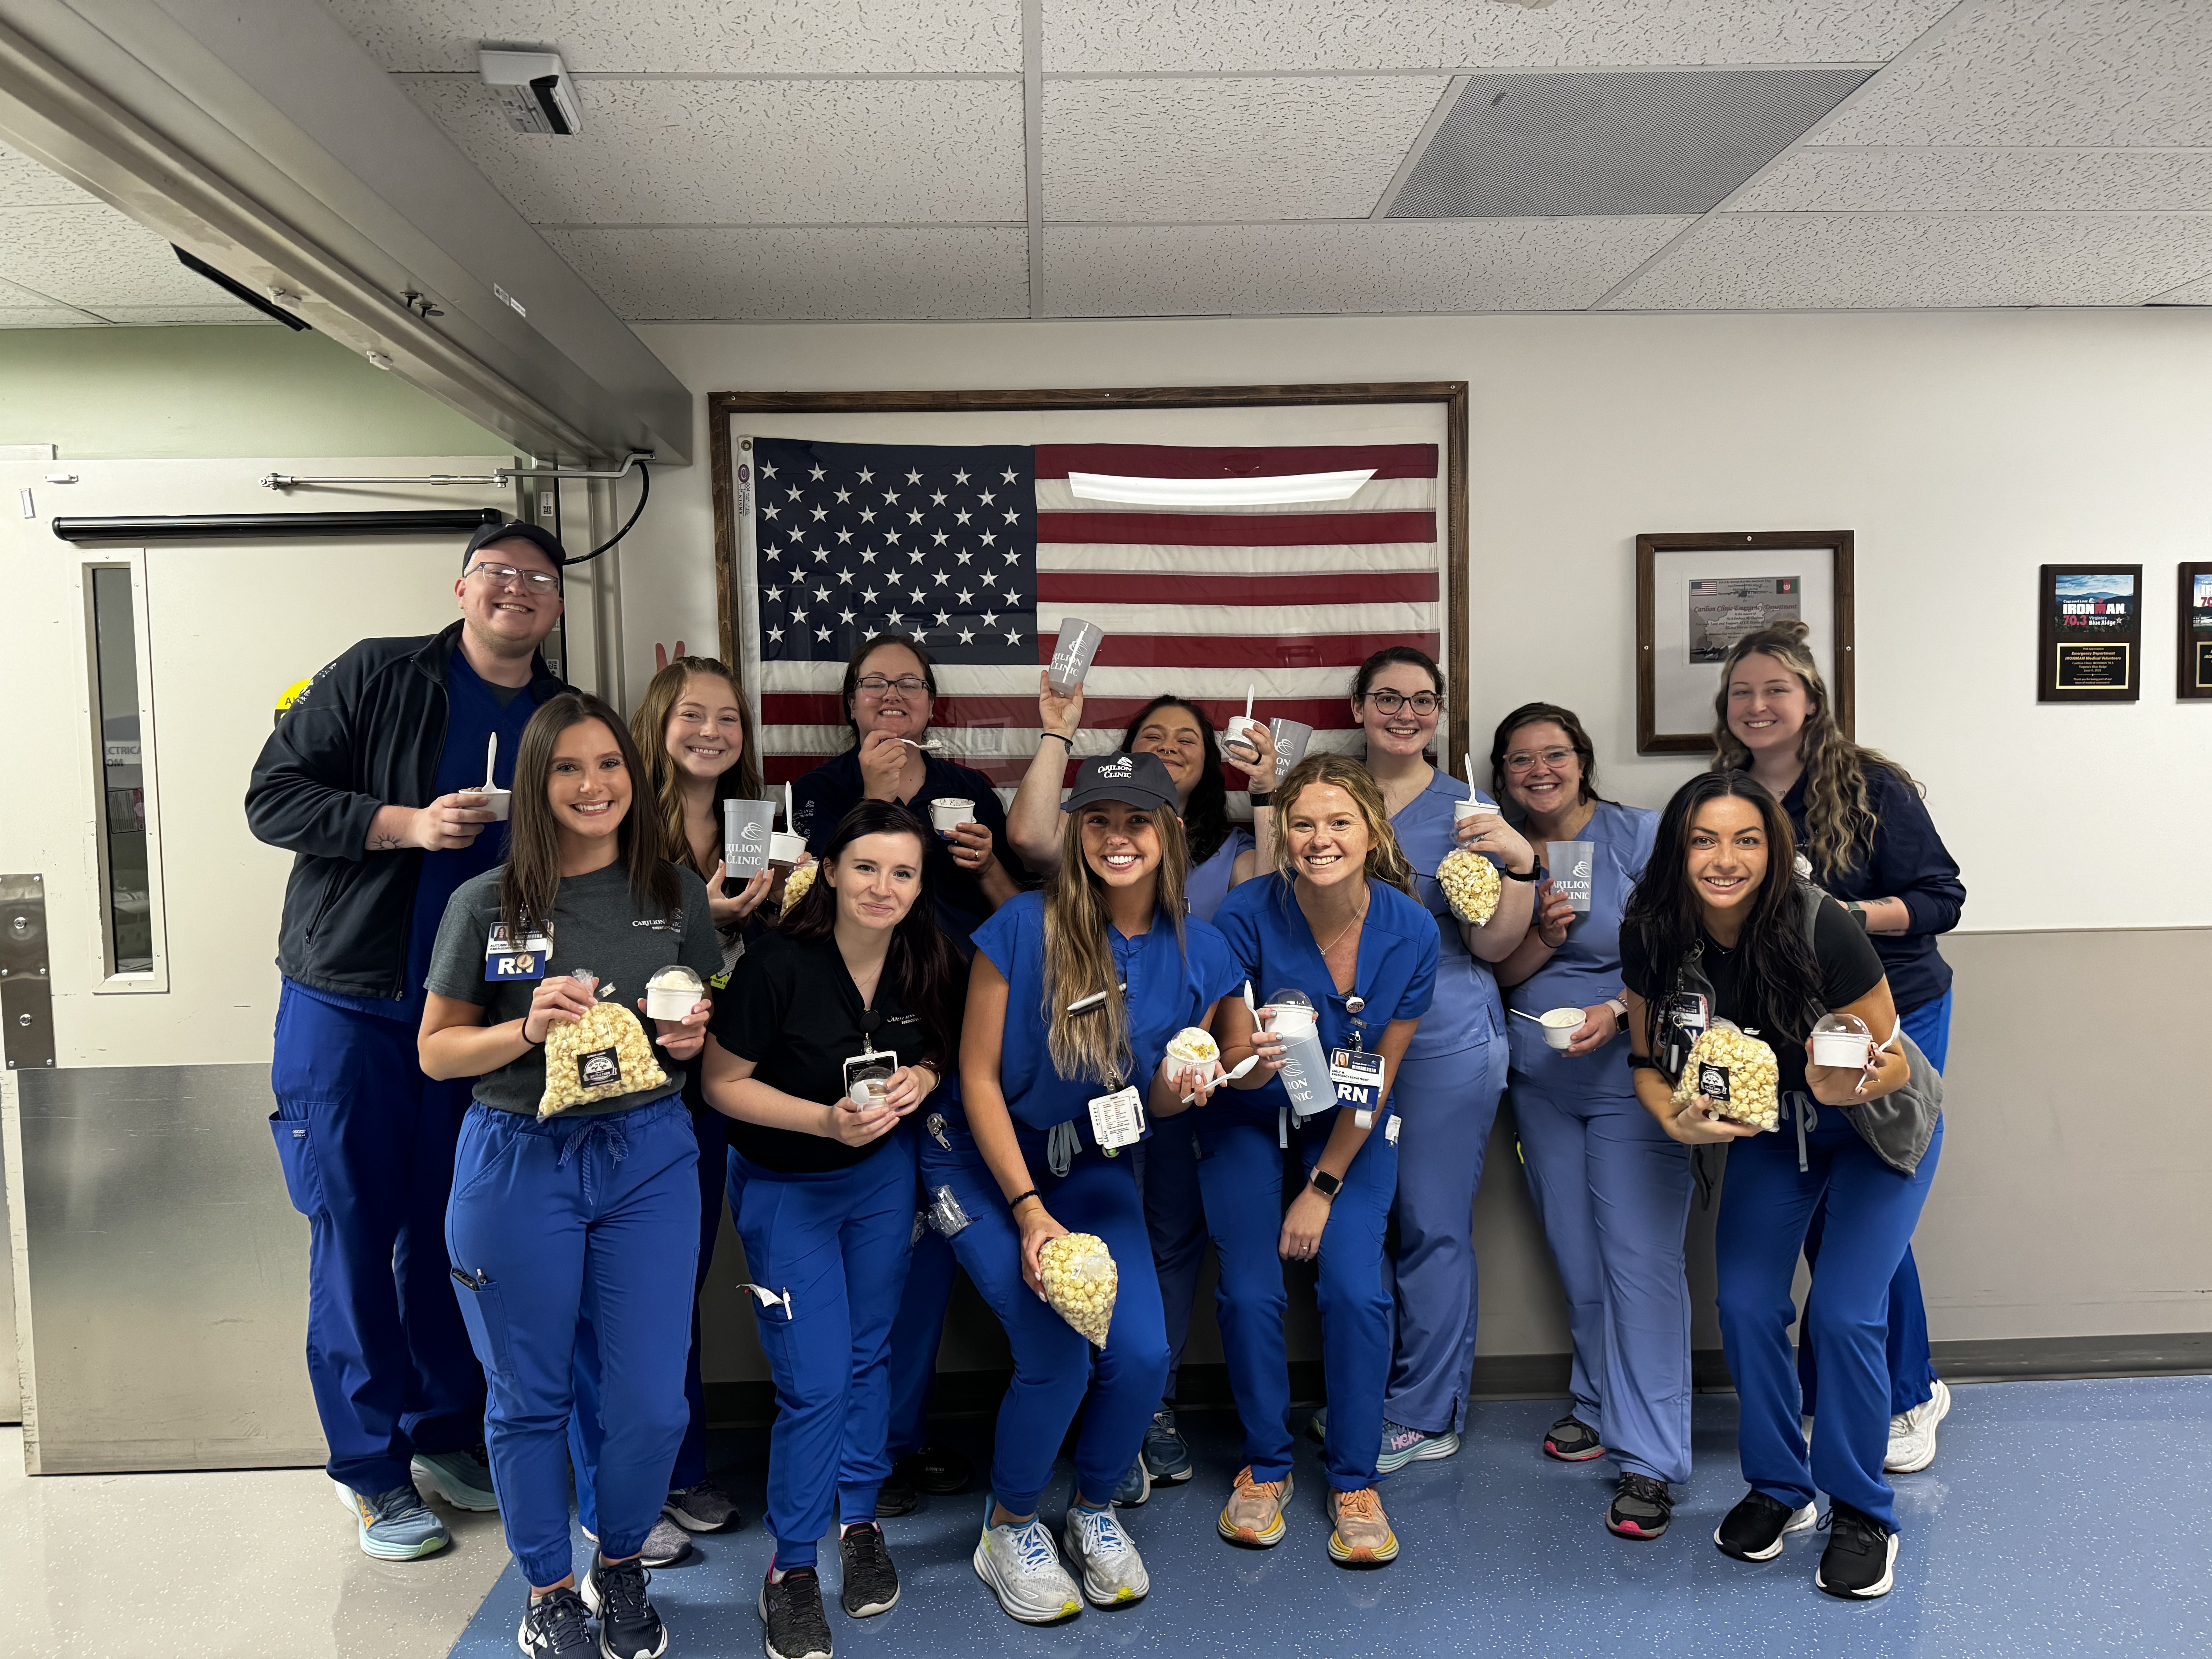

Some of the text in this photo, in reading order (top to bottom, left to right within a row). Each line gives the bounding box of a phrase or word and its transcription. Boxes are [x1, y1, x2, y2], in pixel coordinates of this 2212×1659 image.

[2063, 603, 2125, 615] IRONMAN
[2063, 615, 2087, 626] 70.3
[1053, 653, 1082, 666] RILION
[1098, 765, 1132, 773] CARILION
[726, 843, 762, 854] RILION
[726, 854, 761, 865] CLINIC
[1337, 1084, 1369, 1104] RN
[1391, 1432, 1424, 1451] HOKA
